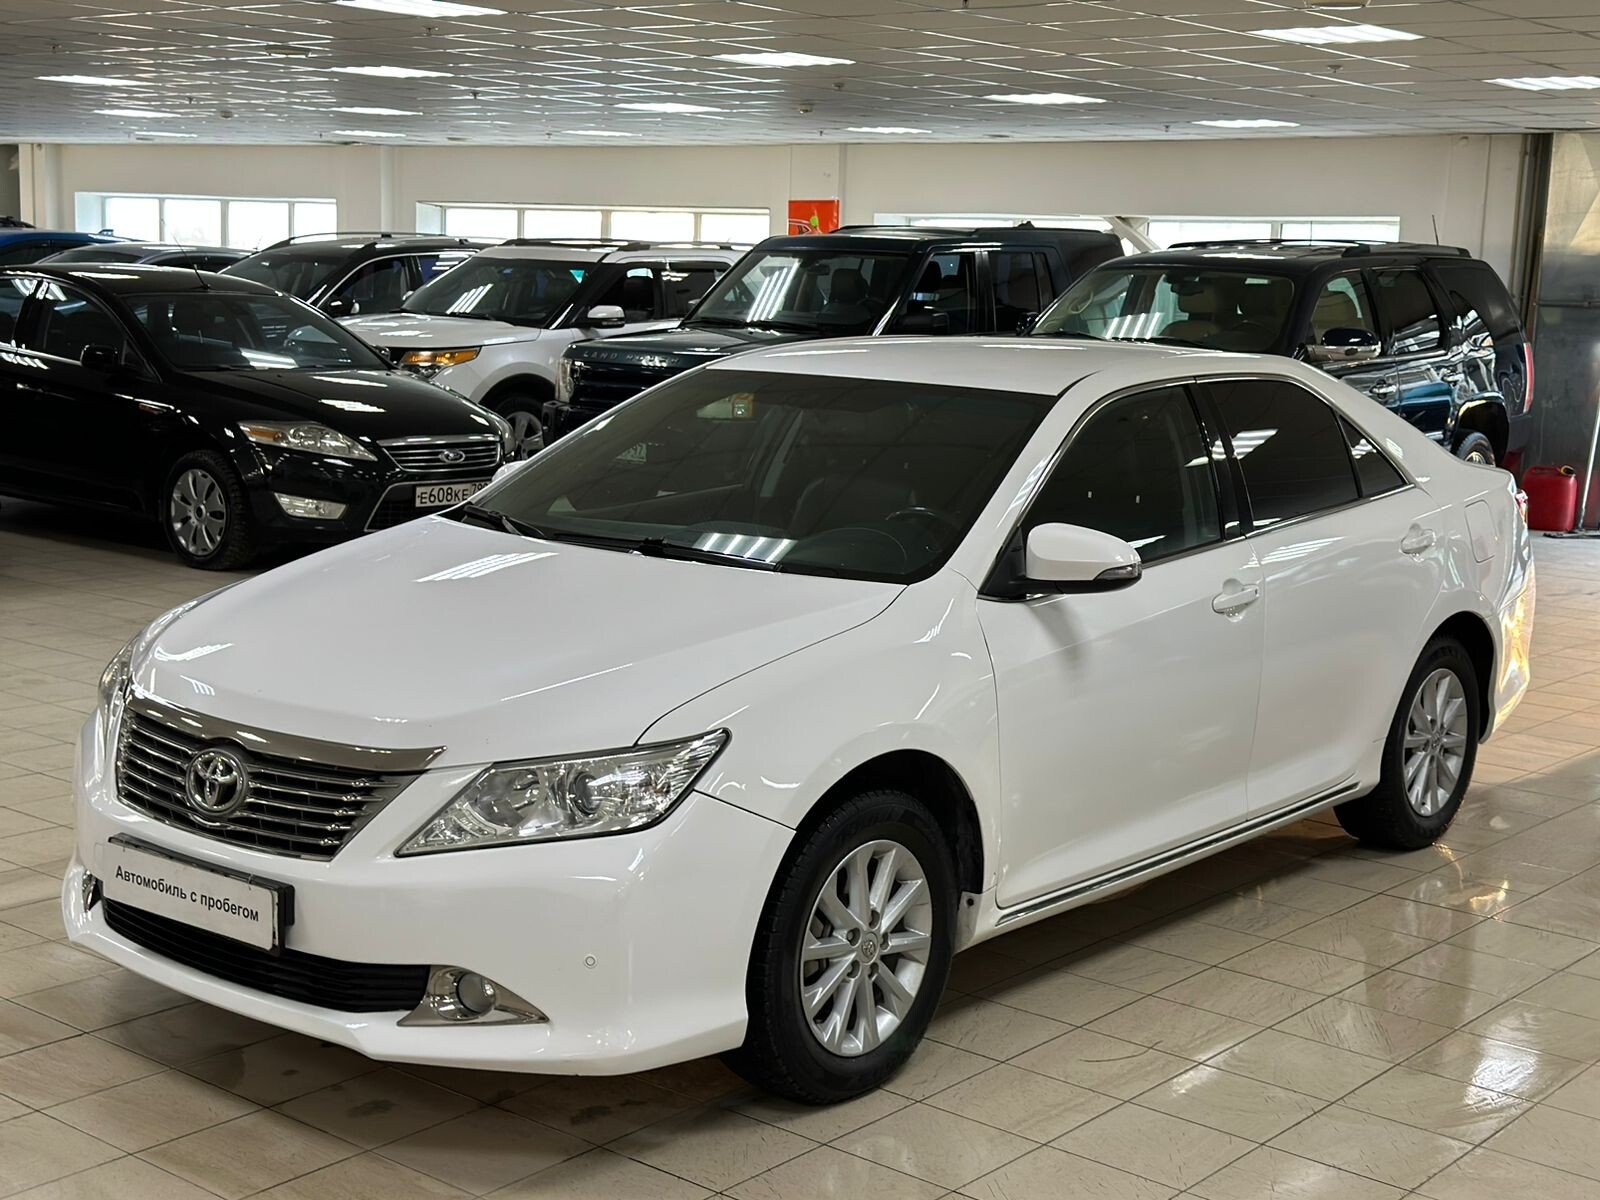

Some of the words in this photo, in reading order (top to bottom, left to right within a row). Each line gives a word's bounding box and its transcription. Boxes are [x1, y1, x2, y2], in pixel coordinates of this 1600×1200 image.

[115, 865, 187, 900] Автомобиль
[190, 891, 197, 903] с
[200, 894, 259, 922] пробегом
